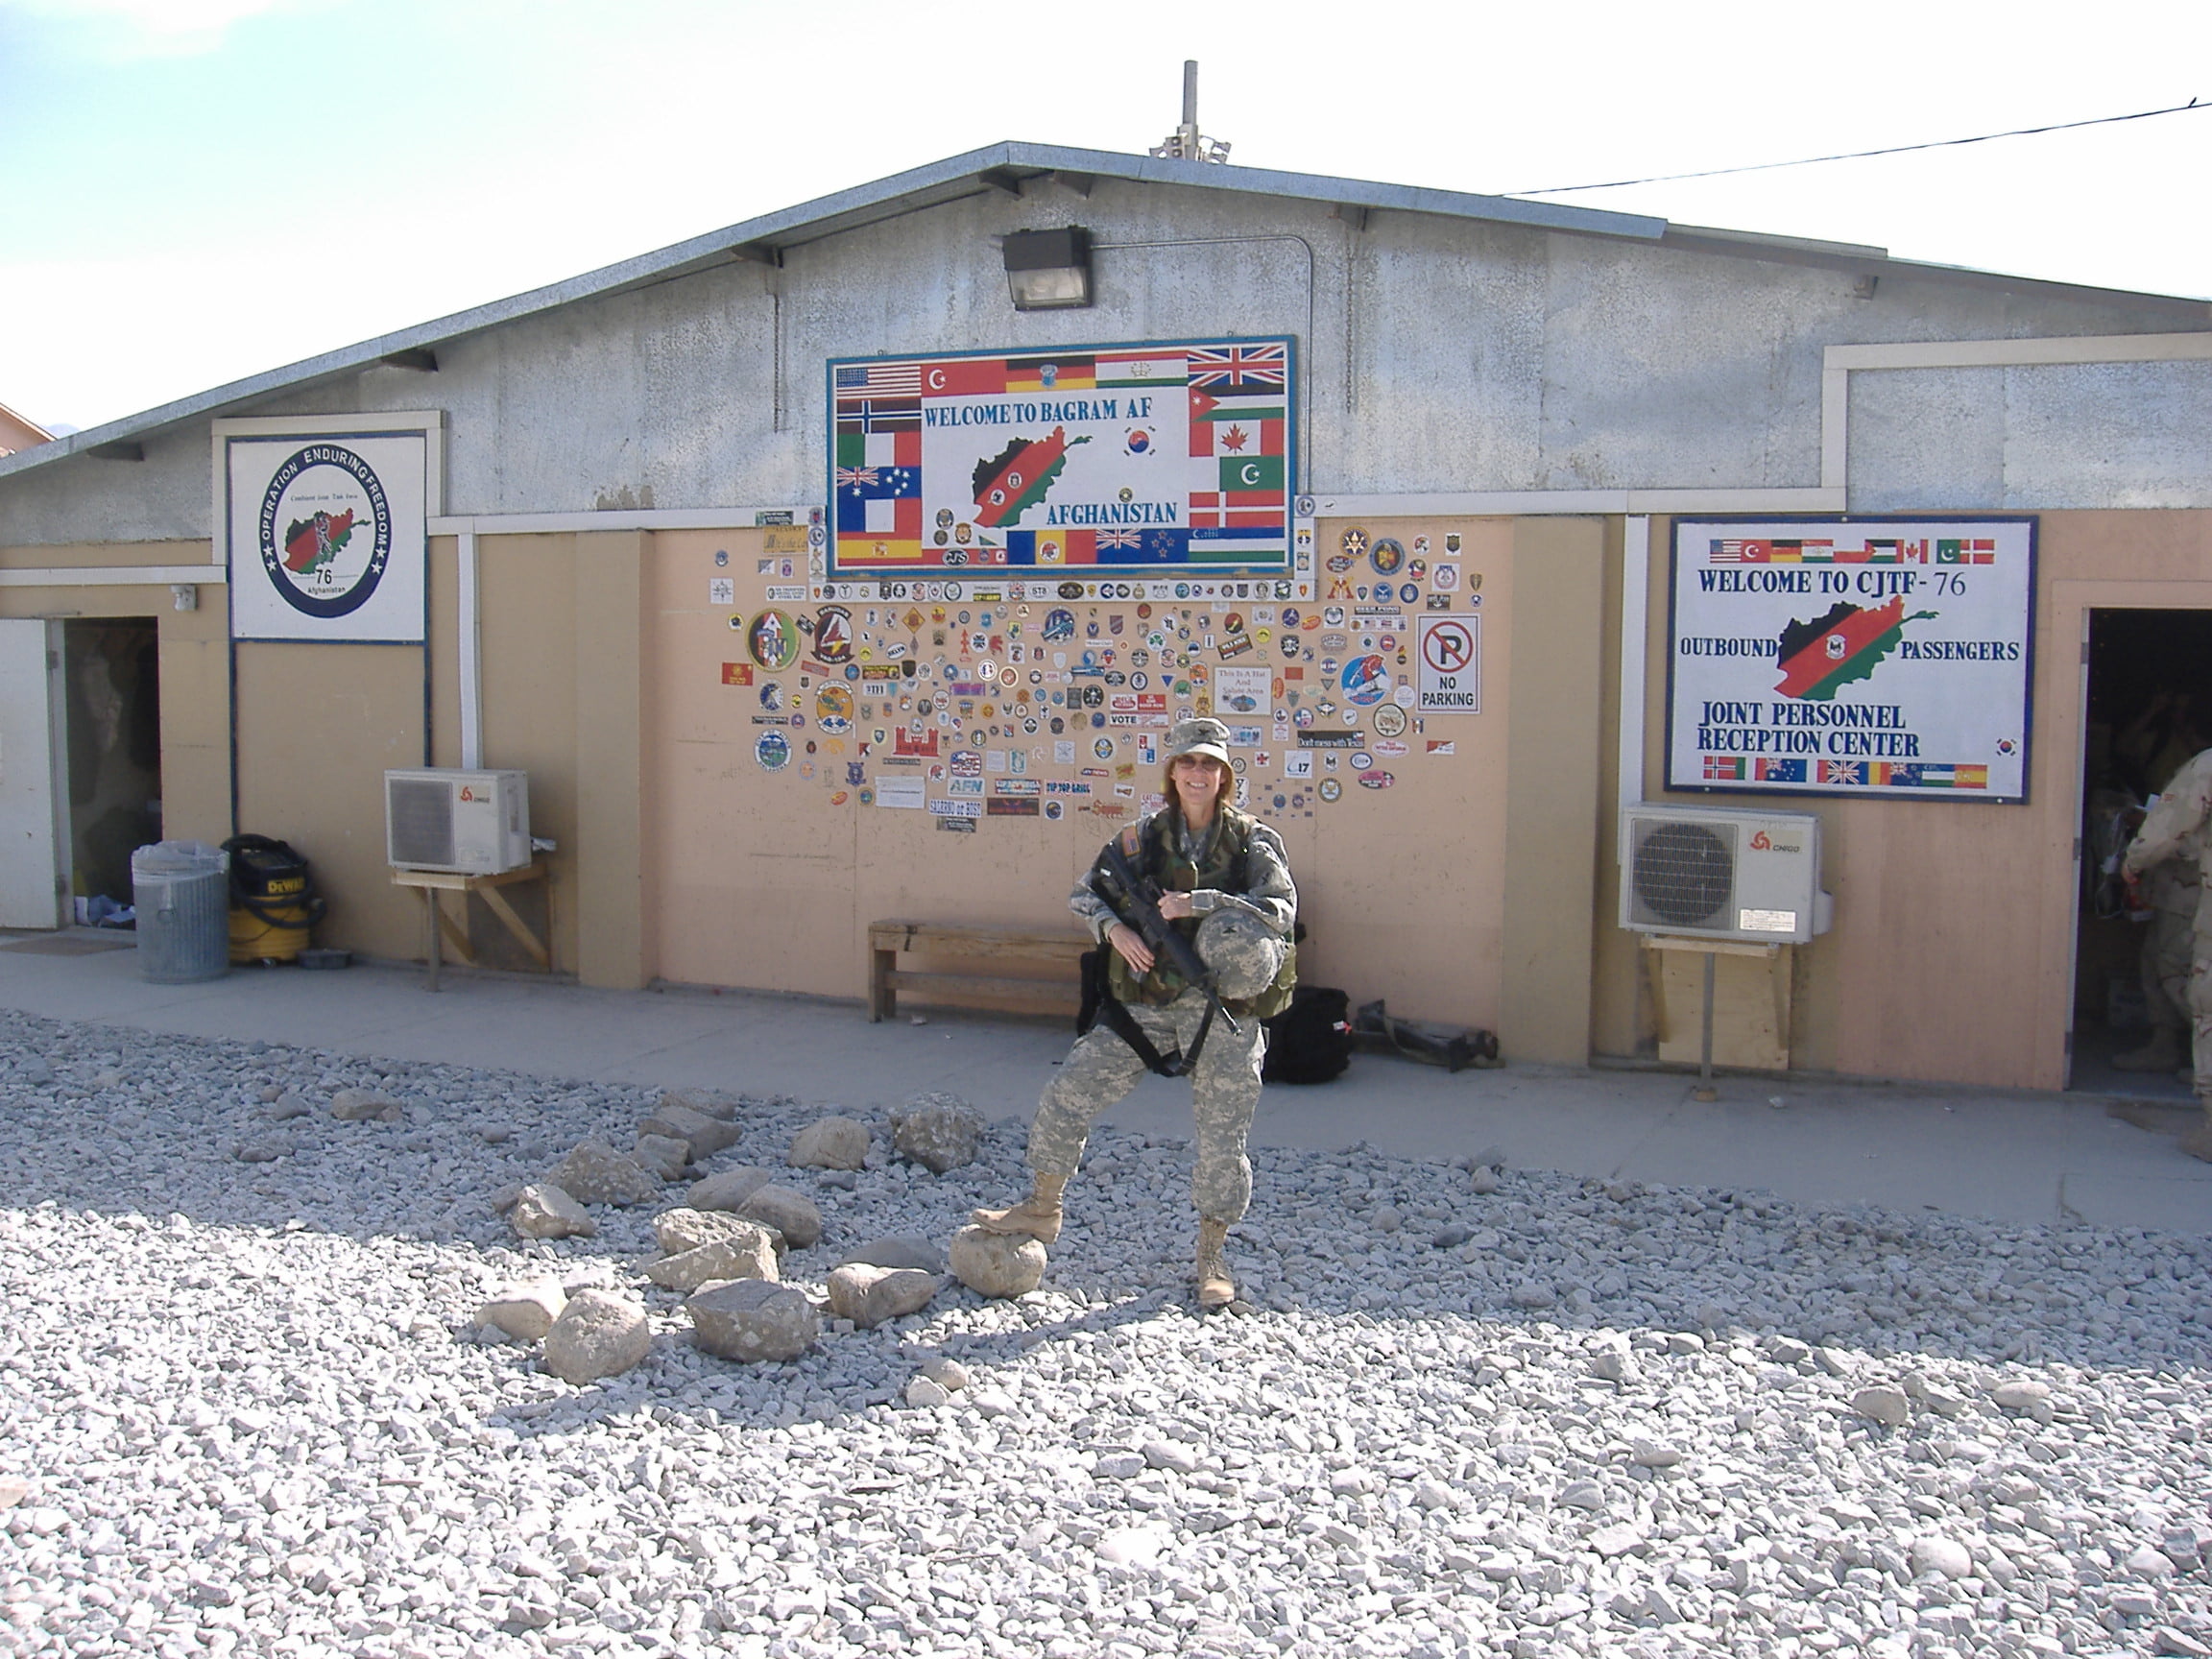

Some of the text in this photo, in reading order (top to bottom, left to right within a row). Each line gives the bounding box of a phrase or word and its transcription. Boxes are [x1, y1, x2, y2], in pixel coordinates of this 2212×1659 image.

[925, 397, 1152, 427] WELCOME TO BAGRAM AF
[261, 447, 388, 545] OPERATION ENDURING FREEDOM
[1046, 502, 1178, 525] AFGHANISTAN
[315, 568, 332, 584] 76
[1697, 569, 1812, 593] WELCOME
[1818, 570, 1849, 593] TO
[307, 586, 347, 595] Afghanistan
[1680, 637, 2020, 661] OUTBOUND PASSENGERS
[1439, 676, 1456, 689] NO
[1422, 691, 1474, 707] PARKING
[1111, 715, 1137, 724] VOTE
[1698, 702, 1906, 729] JOINT PERSONNEL
[1332, 738, 1346, 747] with
[1697, 728, 1919, 757] RECEPTION CENTER
[950, 779, 982, 792] AFN
